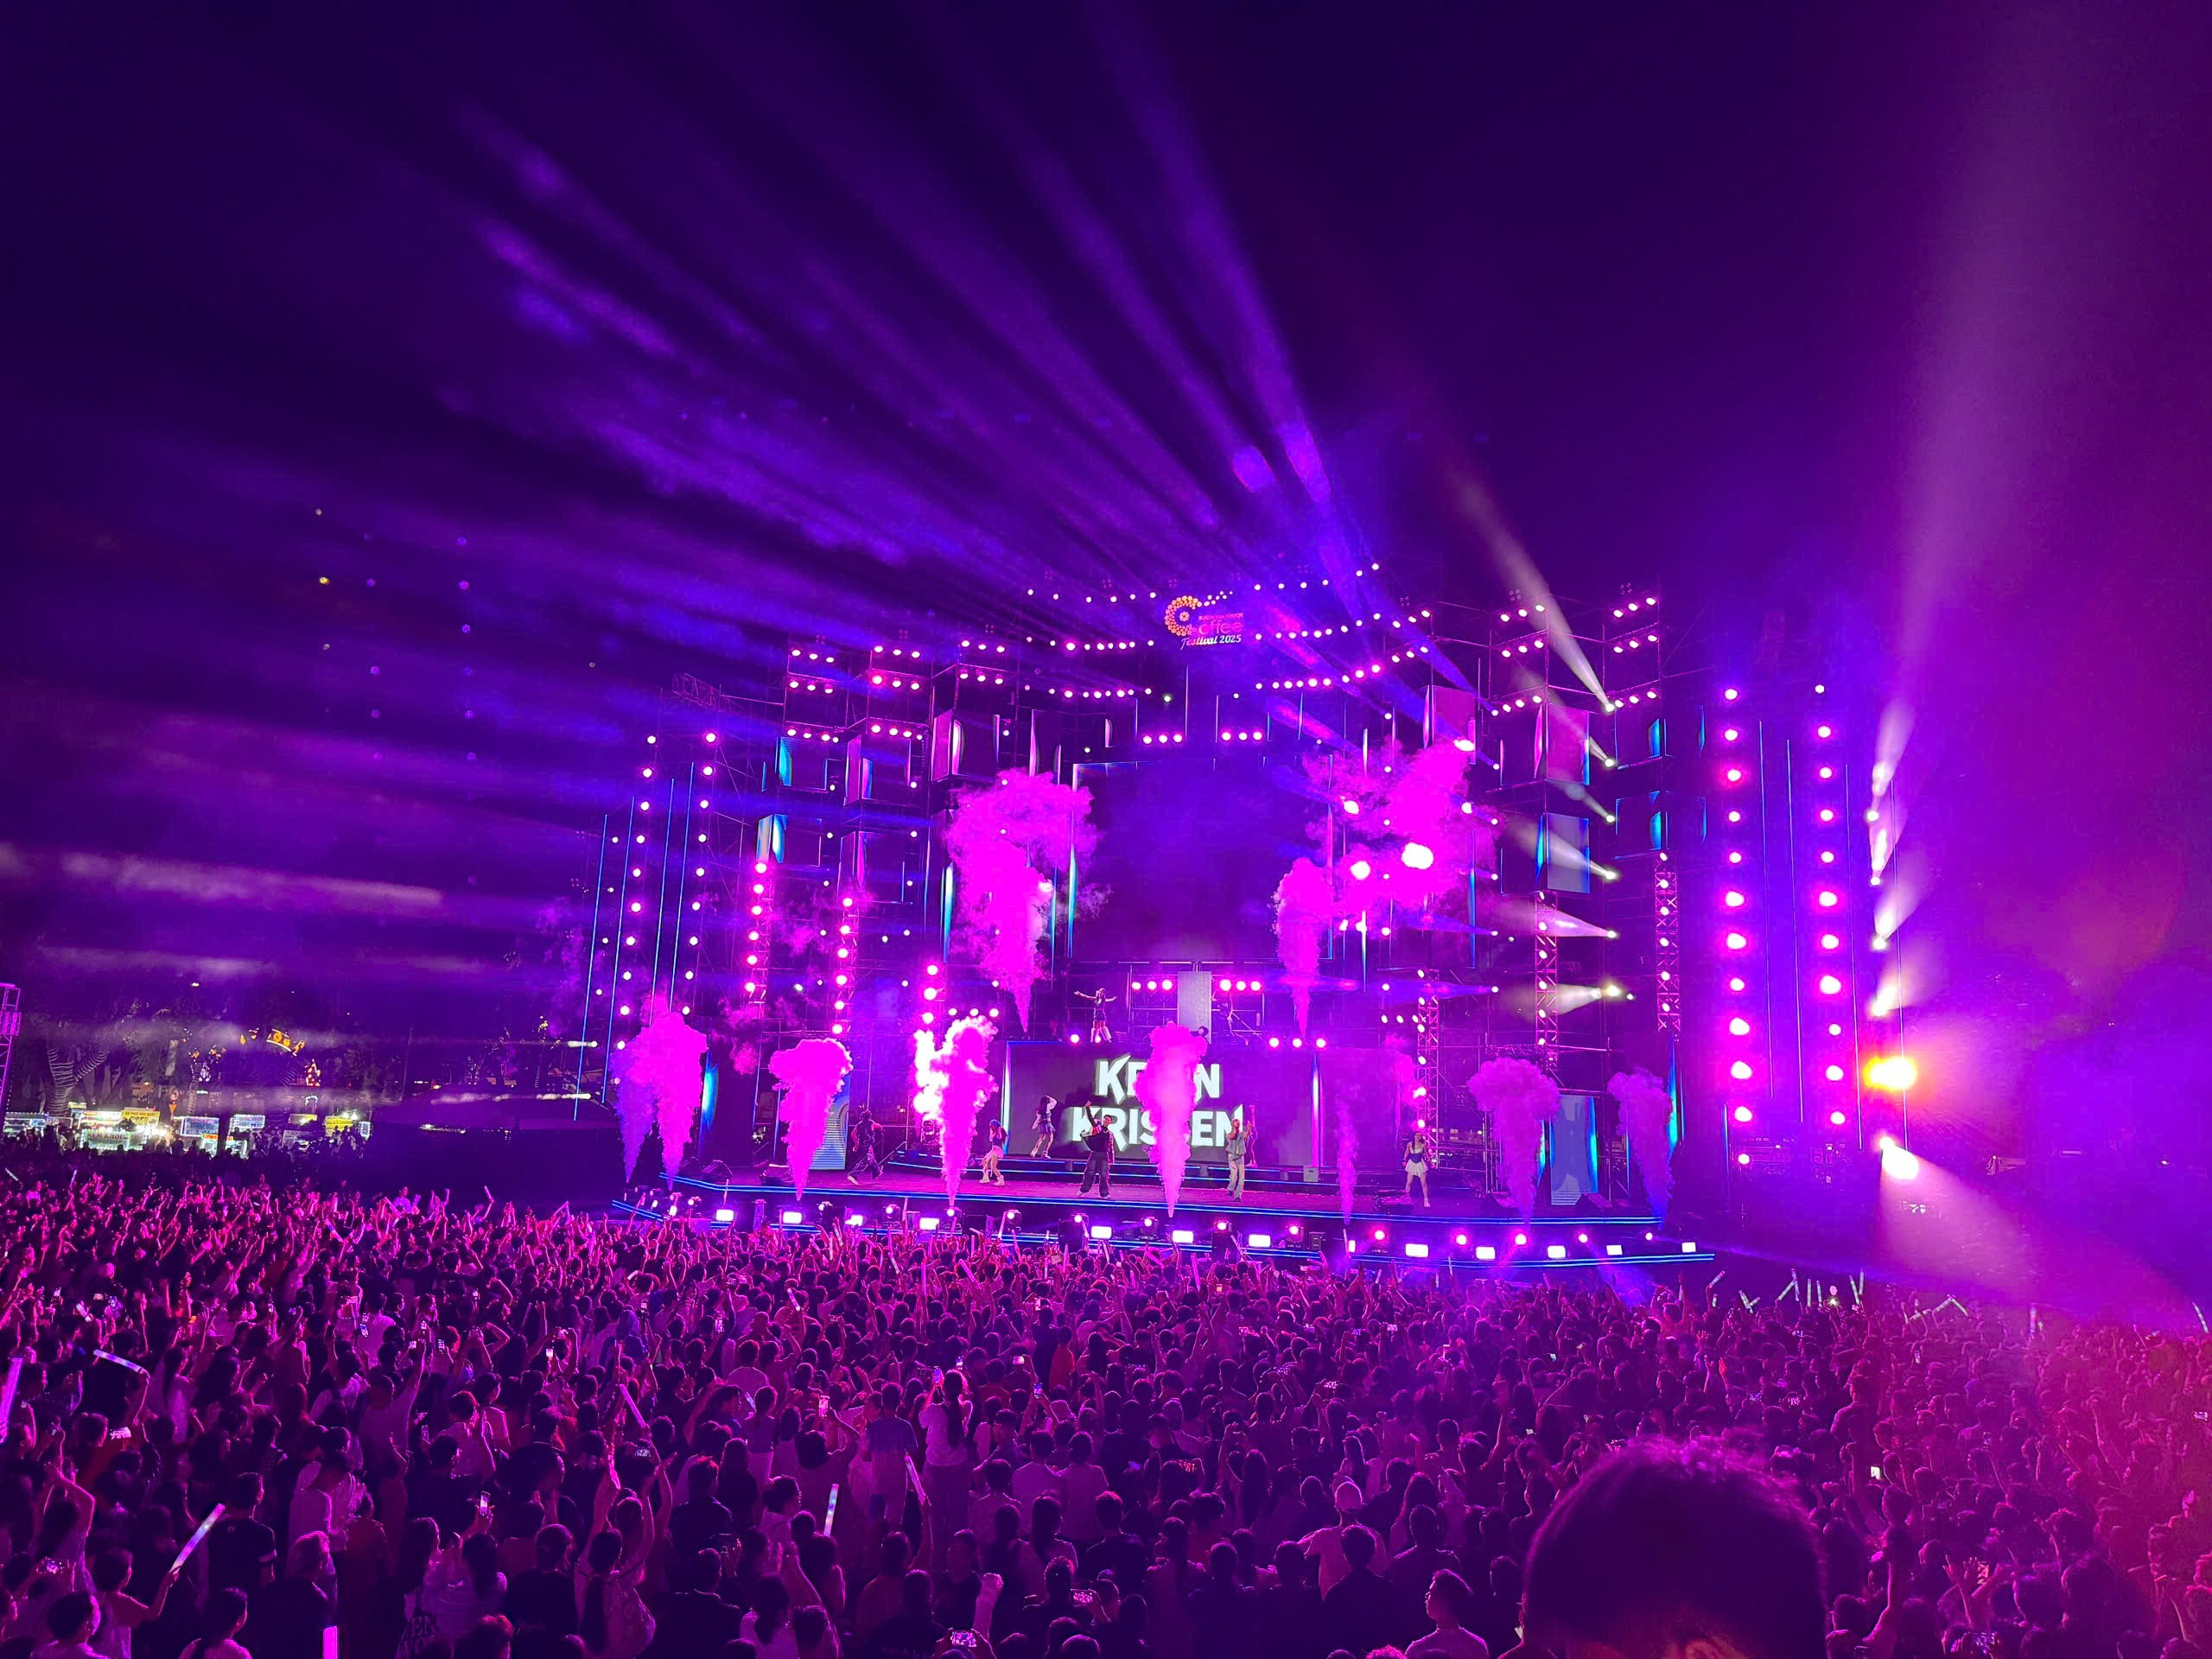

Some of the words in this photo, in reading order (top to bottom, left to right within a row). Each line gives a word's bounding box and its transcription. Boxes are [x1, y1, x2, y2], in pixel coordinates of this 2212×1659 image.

[1179, 635, 1217, 650] Festival
[1219, 634, 1242, 644] 2025
[1071, 1104, 1243, 1152] KRISEN
